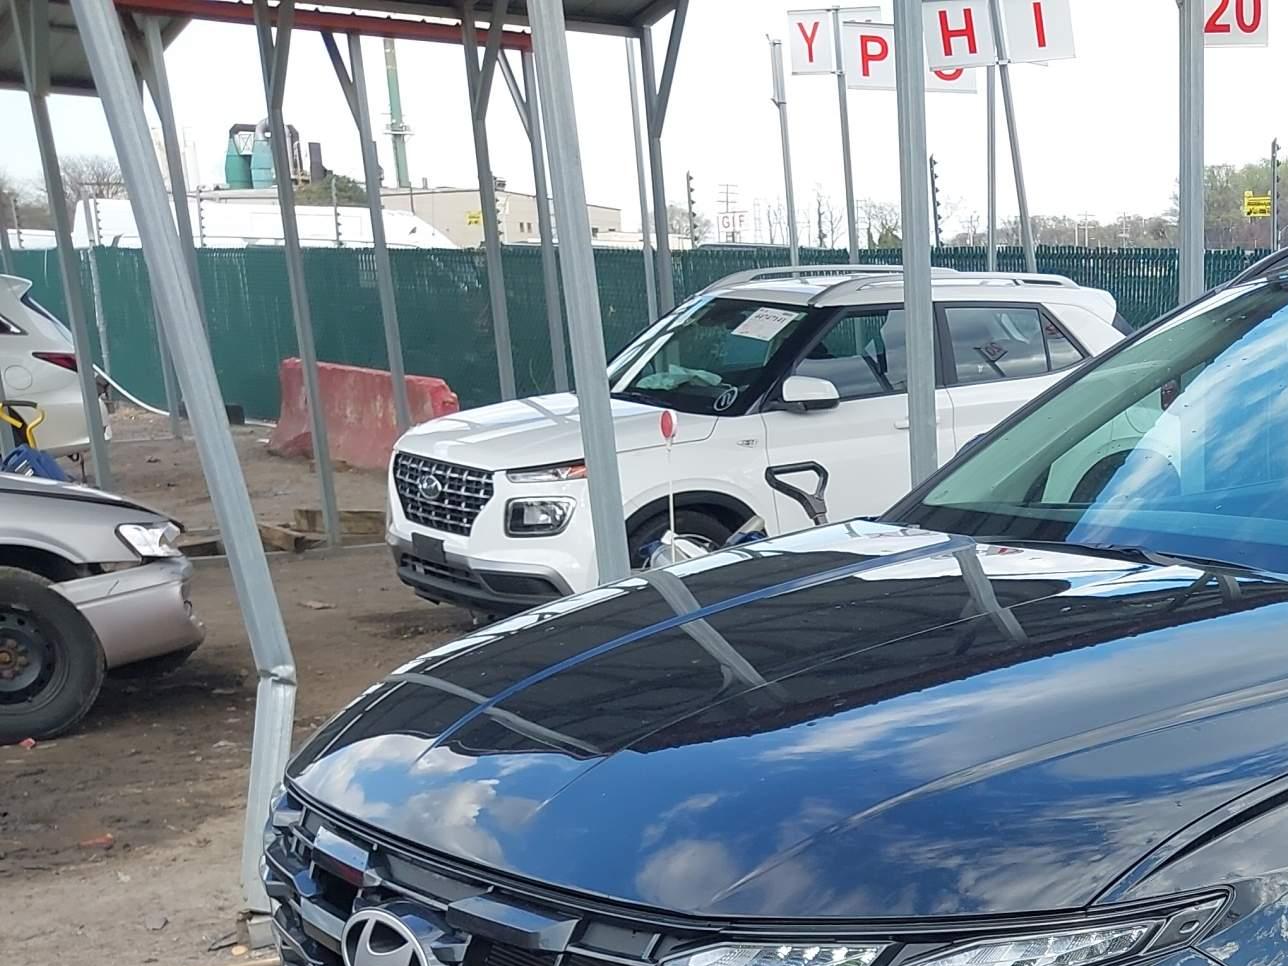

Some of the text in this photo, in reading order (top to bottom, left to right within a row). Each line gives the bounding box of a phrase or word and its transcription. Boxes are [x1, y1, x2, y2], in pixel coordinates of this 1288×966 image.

[938, 8, 978, 57] H
[1032, 2, 1047, 48] I
[1203, 0, 1262, 34] 20
[797, 21, 820, 63] Y
[860, 35, 889, 77] P
[721, 215, 731, 229] G
